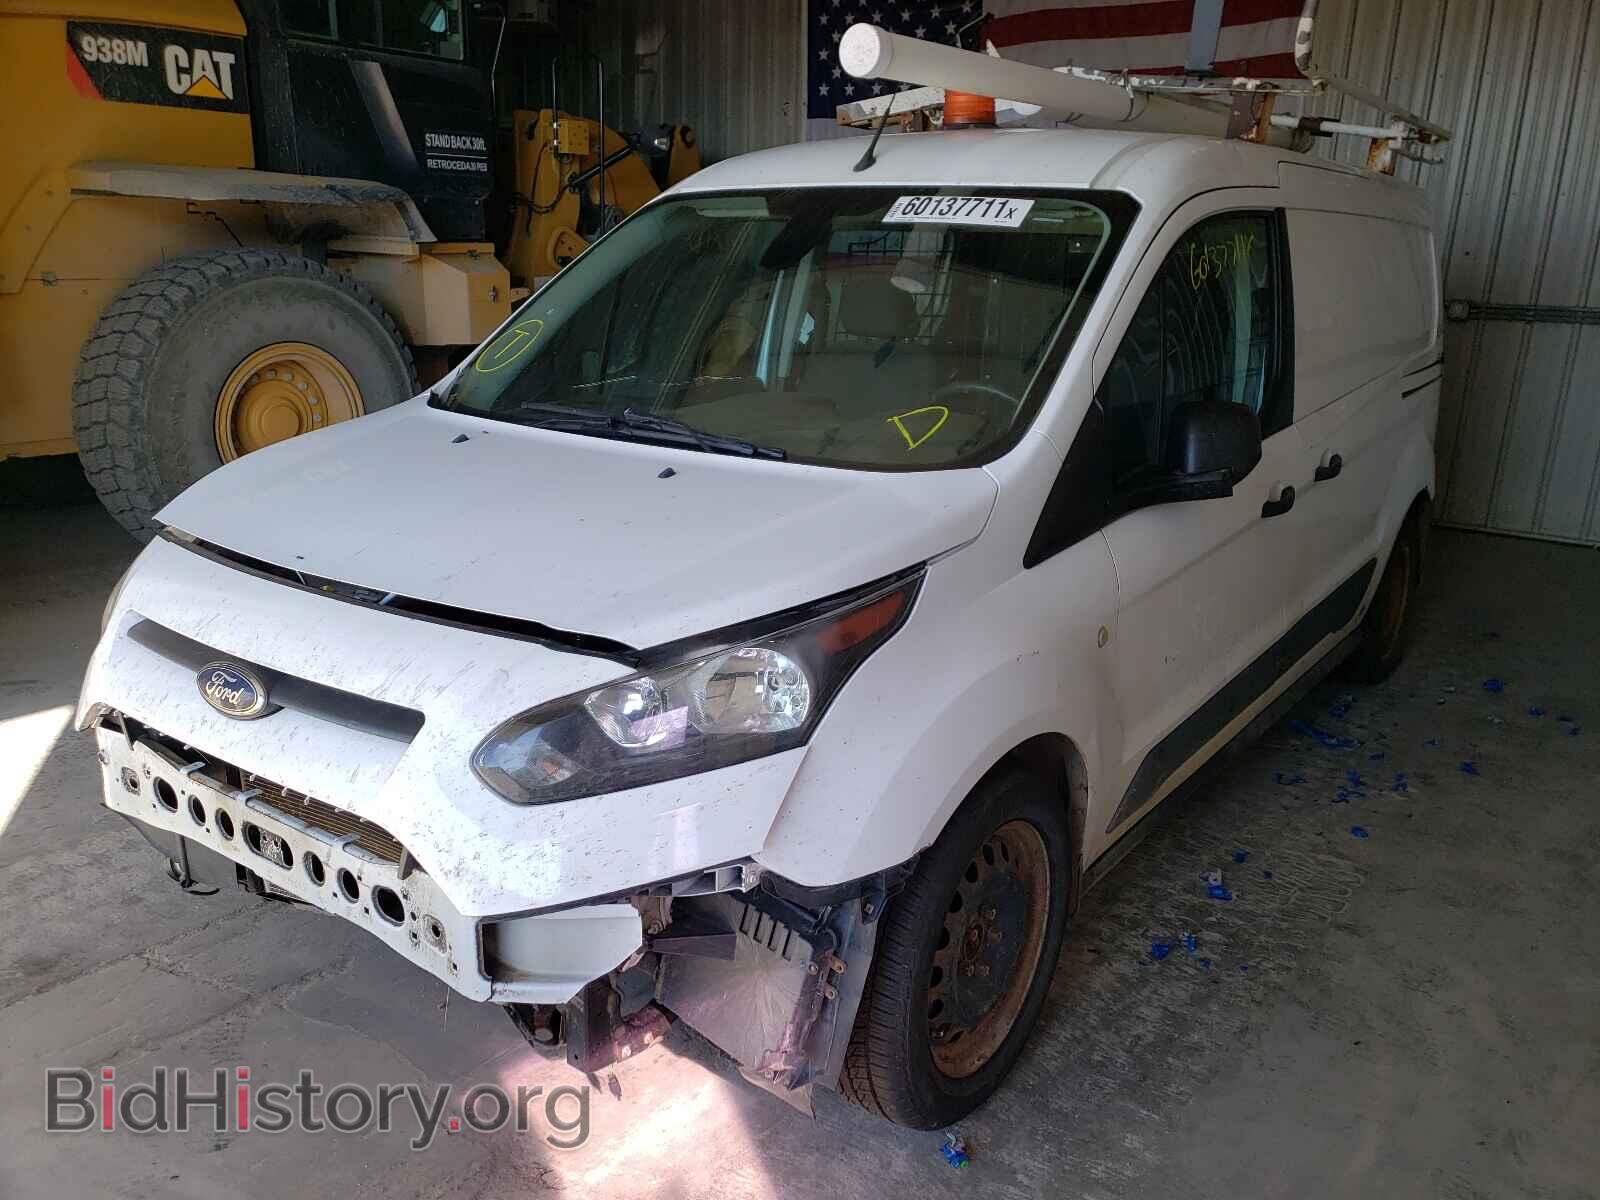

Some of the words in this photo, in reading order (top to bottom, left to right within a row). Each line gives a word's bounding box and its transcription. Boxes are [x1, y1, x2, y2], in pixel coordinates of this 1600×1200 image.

[77, 34, 149, 67] 938M
[163, 43, 236, 101] CAT
[425, 132, 450, 148] STAND
[451, 135, 472, 150] BACK
[205, 670, 246, 705] Ford
